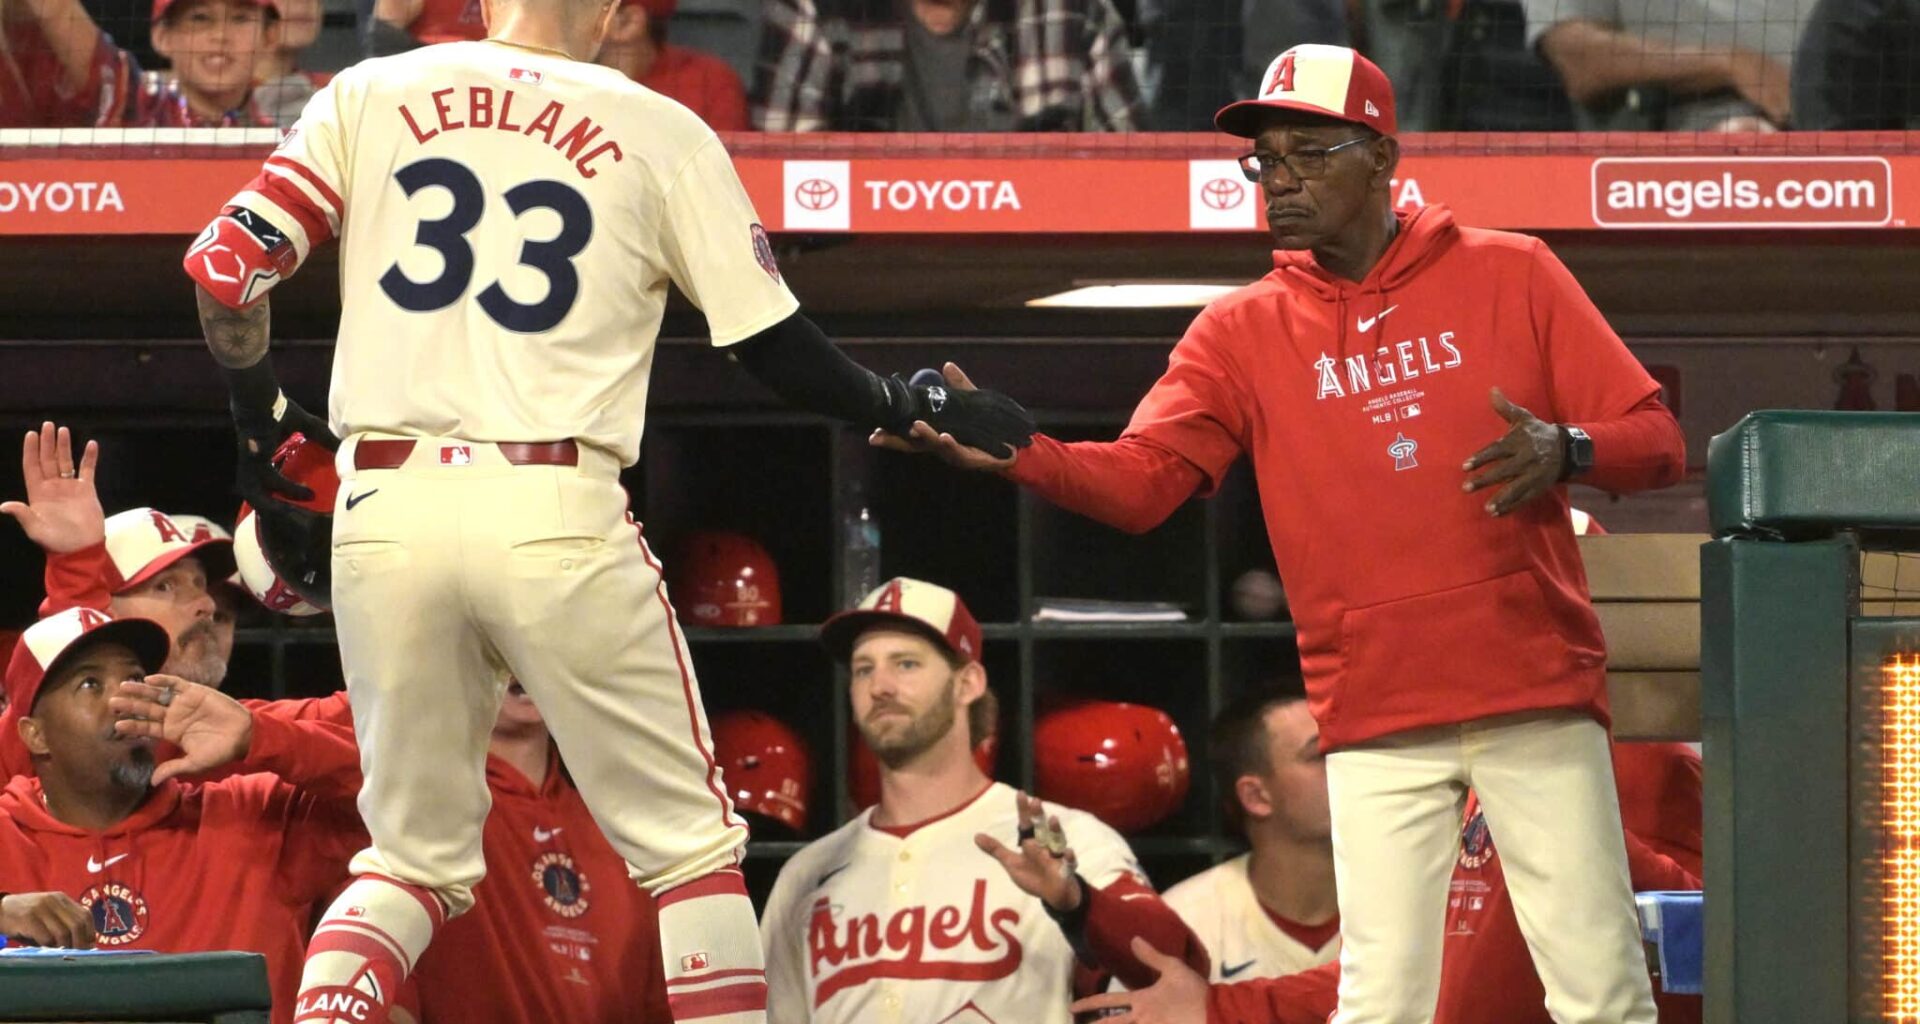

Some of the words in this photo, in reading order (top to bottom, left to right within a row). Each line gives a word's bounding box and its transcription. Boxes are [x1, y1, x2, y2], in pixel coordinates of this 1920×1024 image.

[398, 87, 623, 179] LEBLANC
[864, 179, 1022, 211] TOYOTA
[1607, 172, 1876, 218] angels.com
[378, 157, 595, 334] 33
[1314, 331, 1462, 400] ANGELS
[1372, 413, 1392, 424] MLB
[807, 879, 1023, 1010] Angels
